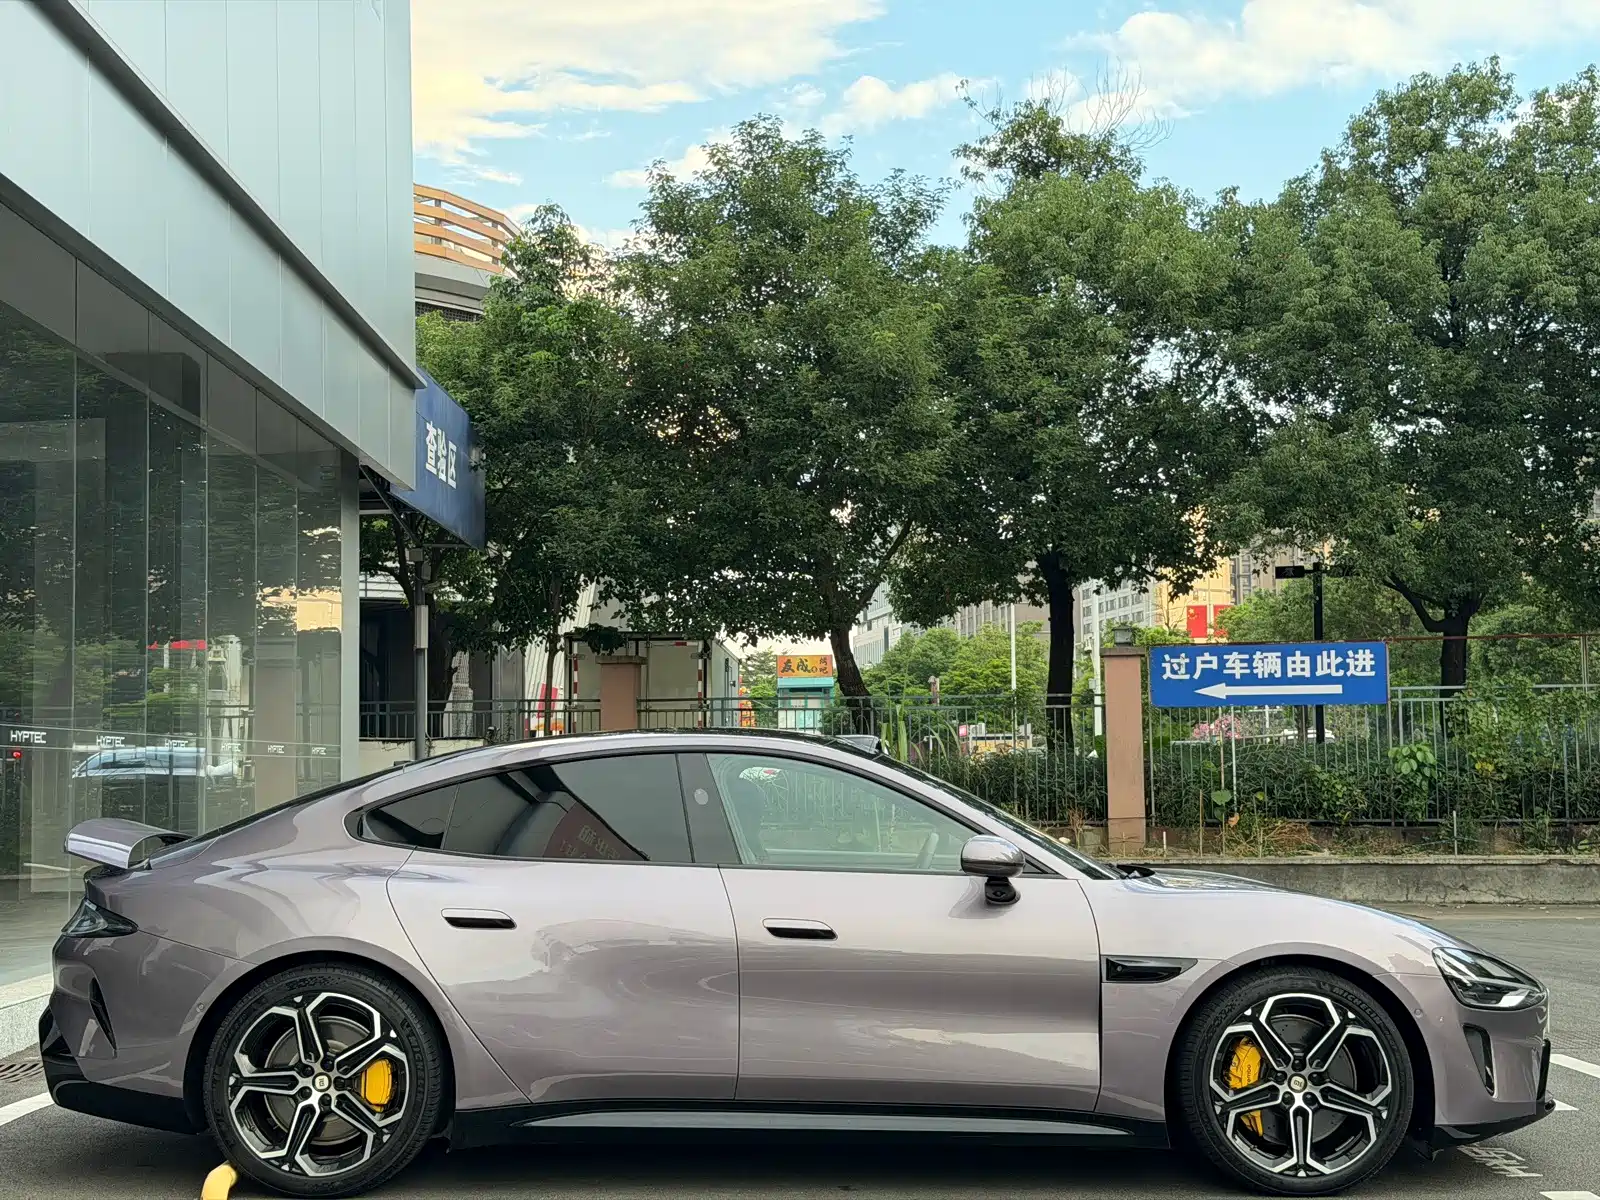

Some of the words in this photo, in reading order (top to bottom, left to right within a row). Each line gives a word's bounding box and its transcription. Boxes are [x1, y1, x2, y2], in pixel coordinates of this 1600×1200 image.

[425, 421, 457, 490] 查验区
[1161, 649, 1376, 681] 过户车辆由此进
[10, 729, 47, 744] HYPTEC
[96, 735, 126, 748] HYPTEC
[1332, 987, 1384, 1027] MICHELIN
